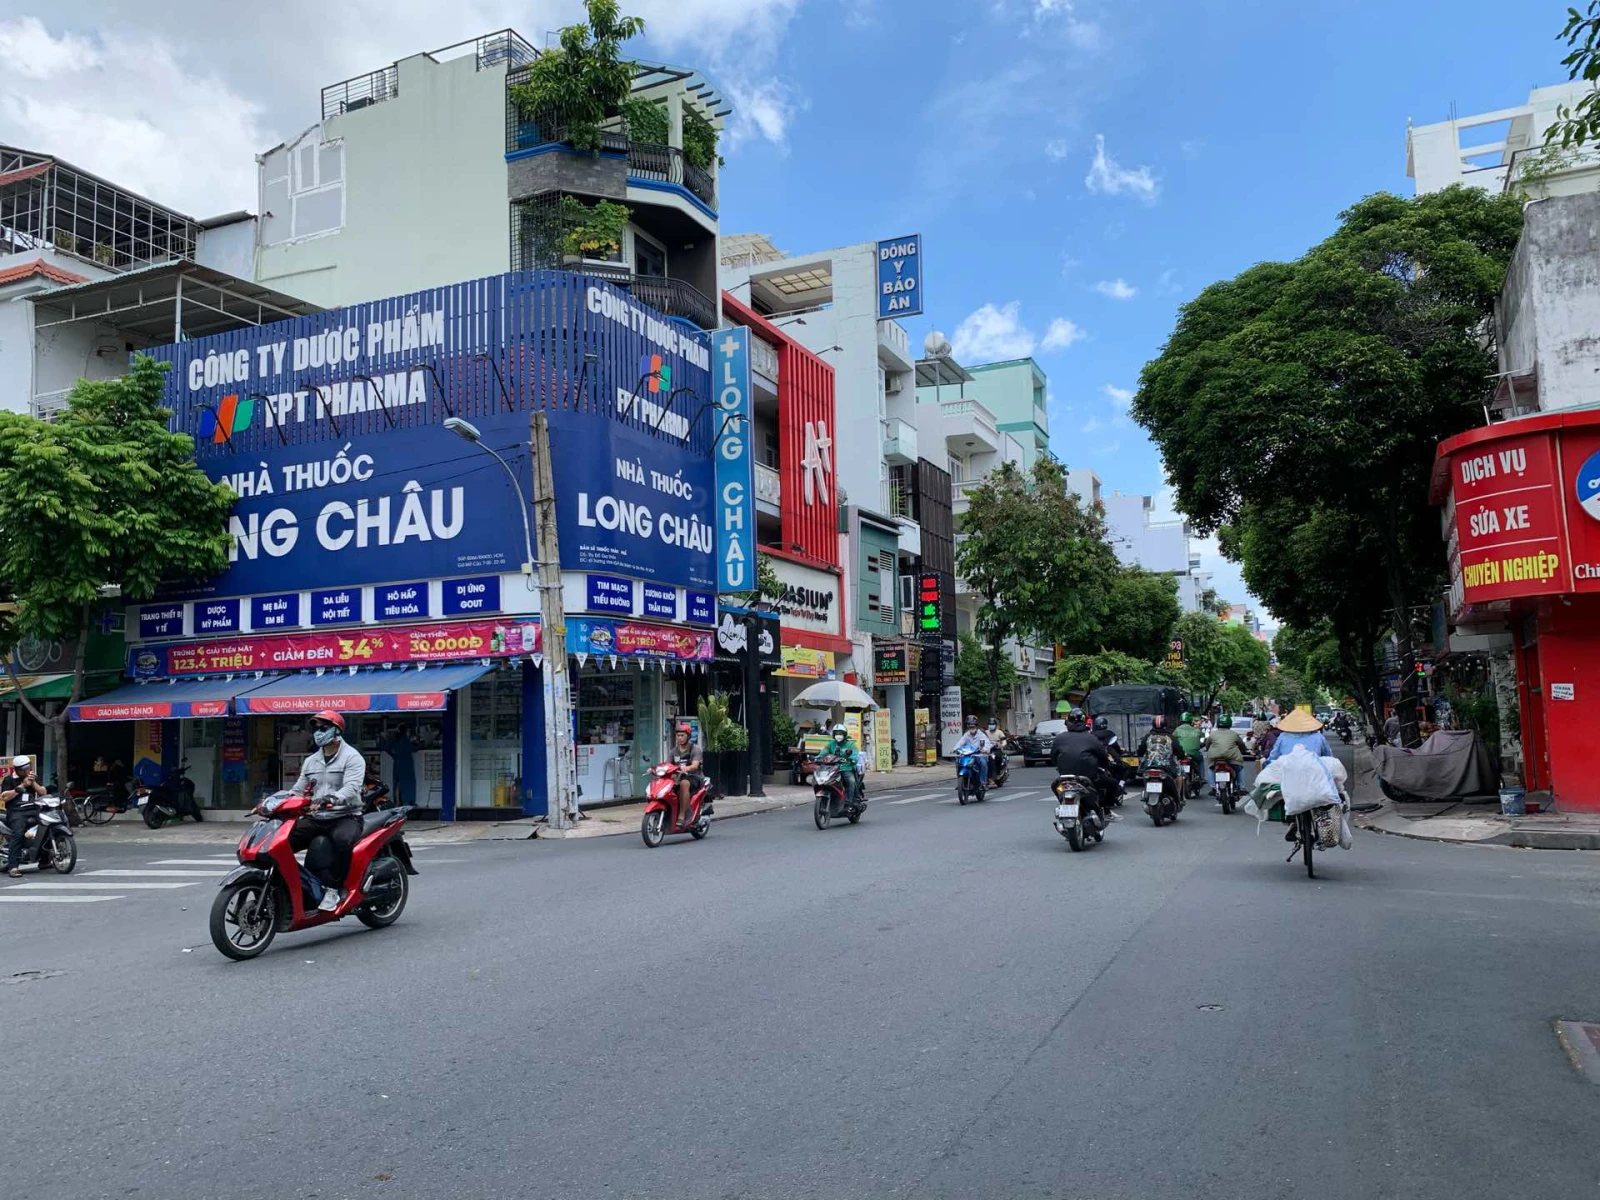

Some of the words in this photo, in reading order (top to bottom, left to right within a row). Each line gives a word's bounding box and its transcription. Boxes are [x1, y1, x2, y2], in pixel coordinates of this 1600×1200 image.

[880, 242, 916, 260] ĐÔNG
[893, 260, 905, 273] Y
[883, 275, 916, 294] BẢO
[587, 286, 630, 328] CÔNG
[630, 305, 646, 336] TY
[647, 316, 678, 354] DƯỢC
[679, 337, 709, 372] PHẨM
[189, 349, 249, 391] CÔNG
[257, 342, 287, 378] TY
[293, 325, 360, 371] DƯỢC
[367, 304, 444, 357] PHẨM
[265, 390, 309, 428] FPT
[316, 370, 426, 420] PHARMA
[617, 387, 639, 420] FPT
[641, 398, 690, 442] PHARMA
[720, 361, 744, 460] LONG
[222, 461, 274, 498] NHÀ
[283, 442, 374, 492] THUỐC
[1461, 454, 1496, 486] DỊCH
[1499, 448, 1526, 476] VỤ
[616, 457, 645, 486] NHÀ
[650, 469, 692, 501] THUỐC
[228, 508, 299, 562] NG
[315, 480, 464, 551] CHÂU
[578, 492, 653, 538] LONG
[659, 513, 713, 554] CHÂU
[1470, 505, 1500, 537] SỬA
[1504, 505, 1530, 531] XE
[722, 481, 745, 587] CHÂU
[1464, 558, 1499, 588] CHUYÊN
[1503, 550, 1558, 583] NGHIỆP
[387, 591, 399, 600] HÔ
[400, 588, 417, 599] HẤP
[457, 586, 466, 596] DỊ
[467, 583, 485, 594] ỨNG
[597, 581, 610, 590] TIM
[611, 582, 628, 594] MẠCH
[335, 592, 349, 603] LIỄU
[593, 592, 609, 605] TIỂU
[610, 595, 630, 608] ĐƯỜNG
[645, 589, 662, 599] XƯƠNG
[663, 589, 676, 601] KHỚP
[696, 596, 706, 604] GAN
[207, 605, 227, 615] DƯỢC
[262, 603, 273, 613] MẸ
[274, 599, 288, 610] BẦU
[384, 605, 401, 615] TIÊU
[402, 604, 420, 614] HÓA
[460, 599, 483, 609] GOUT
[648, 601, 661, 613] THẦN
[662, 605, 673, 614] KINH
[141, 612, 161, 621] TRANG
[161, 609, 176, 619] THIẾT
[176, 610, 183, 619] BỊ
[265, 617, 276, 625] EM
[276, 614, 285, 624] BÉ
[322, 609, 336, 620] NỘI
[337, 606, 350, 618] TIẾT
[693, 608, 700, 619] DẠ
[700, 608, 709, 617] DÀY
[160, 623, 168, 633] TẾ
[202, 618, 212, 629] MỸ
[213, 616, 232, 628] PHẨM
[173, 649, 195, 657] TRÚNG
[206, 647, 220, 655] GIẢI
[222, 646, 236, 654] TIỀN
[238, 645, 253, 653] MẶT
[273, 648, 304, 662] GIẢM
[307, 645, 333, 660] ĐẾN
[338, 638, 384, 660] 34%
[410, 636, 483, 652] 30.000Đ
[211, 653, 253, 669] TRIỆU
[112, 707, 130, 716] HÀNG
[130, 707, 143, 716] TẬN
[272, 701, 291, 709] GIAO
[292, 699, 314, 708] HÀNG
[315, 699, 331, 710] TẬN
